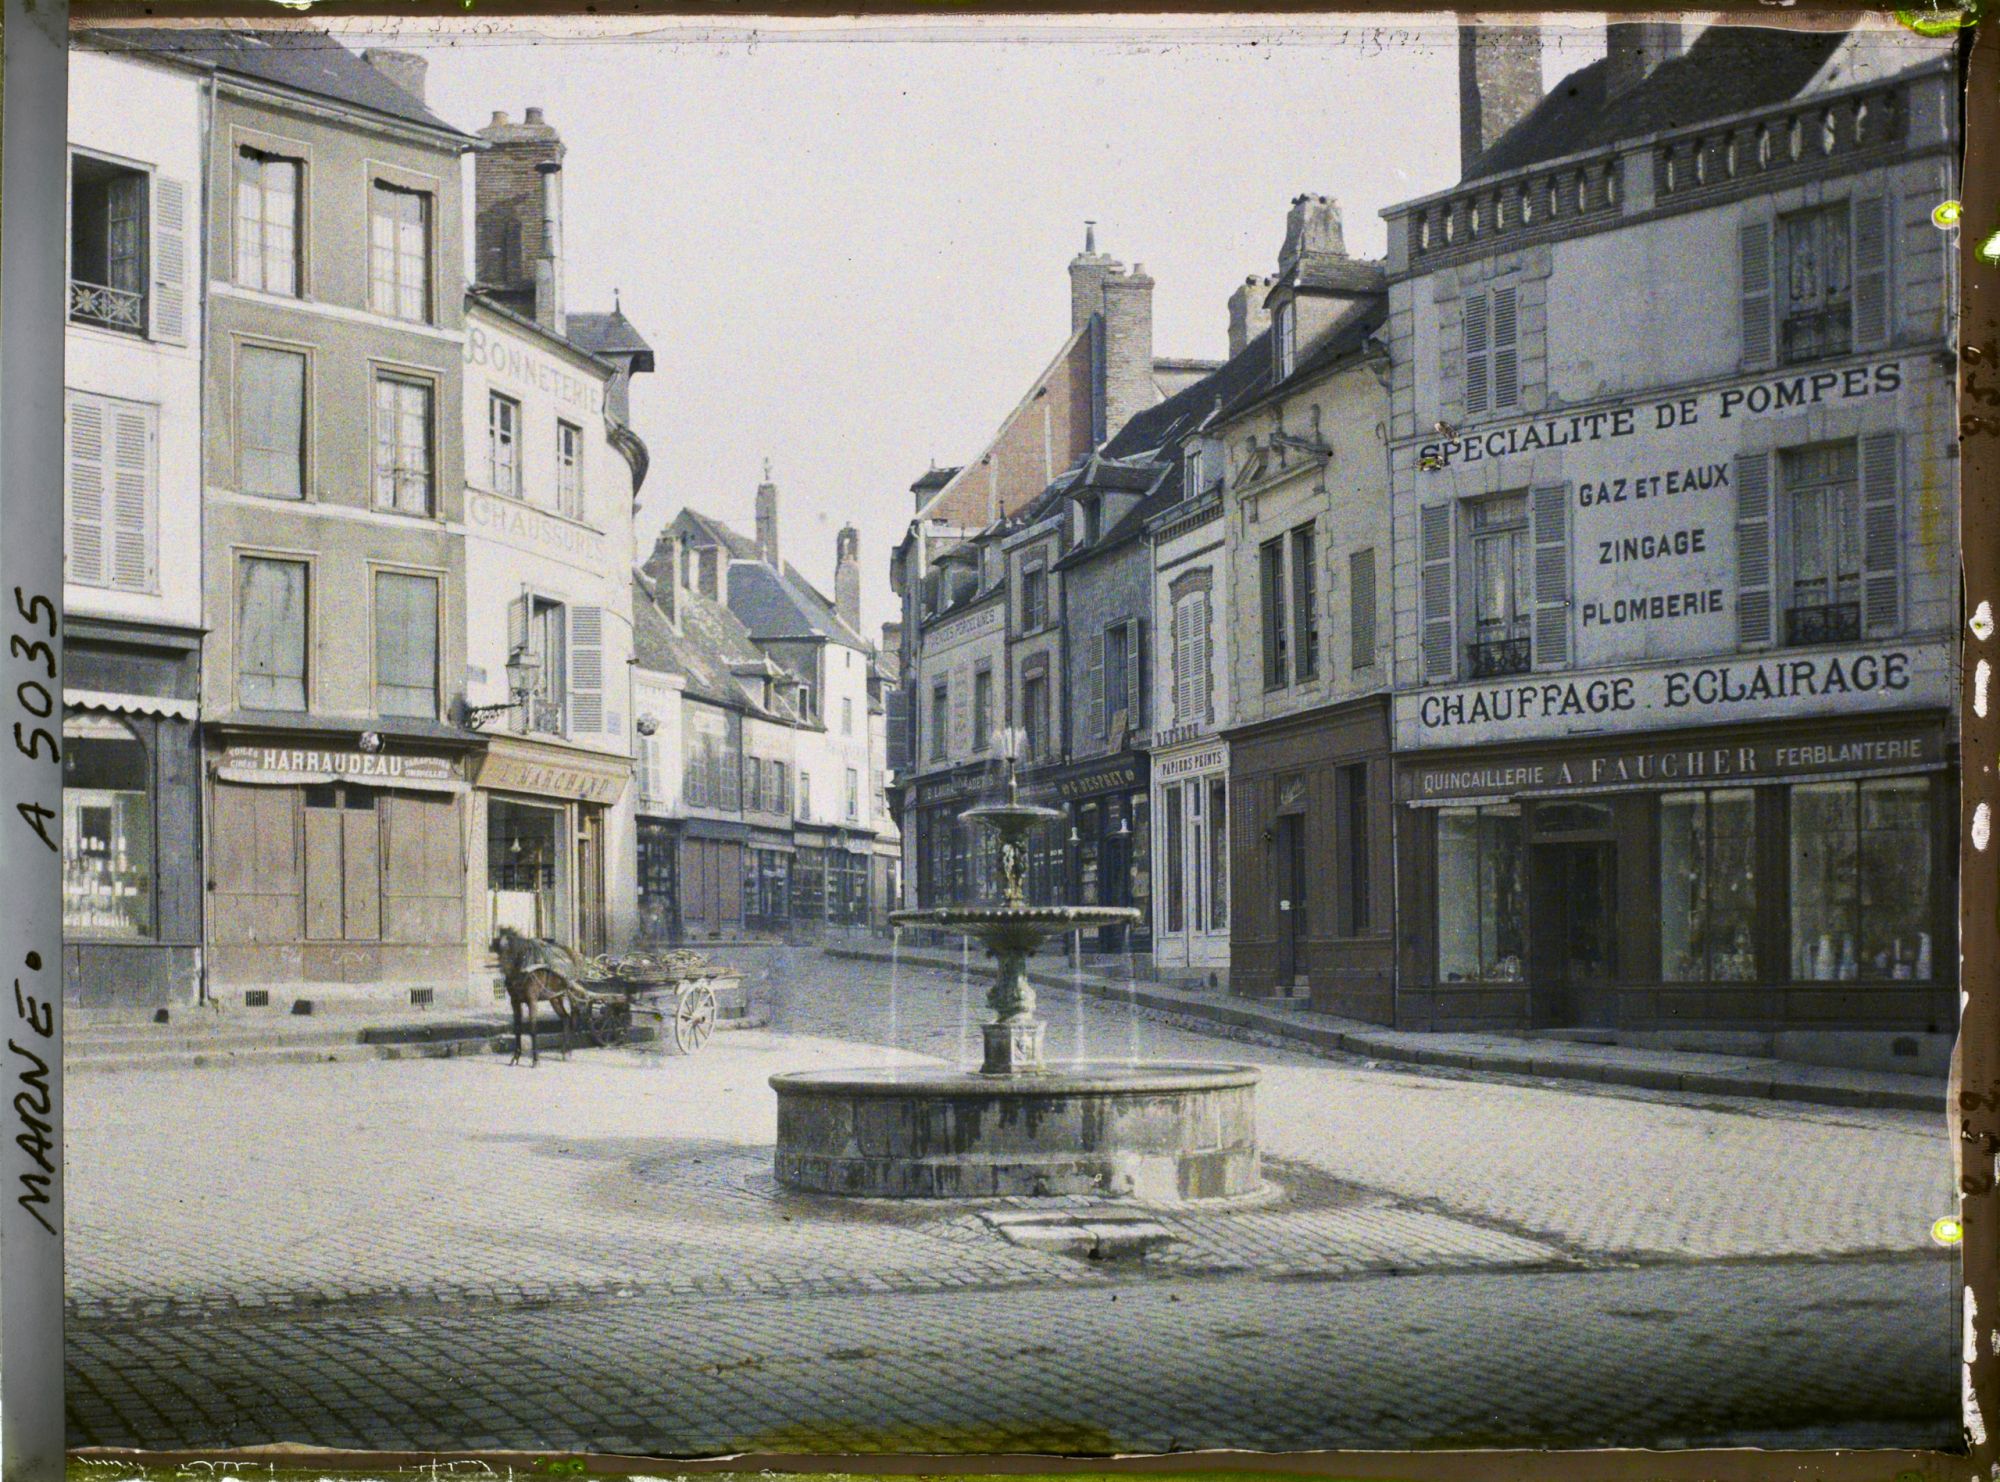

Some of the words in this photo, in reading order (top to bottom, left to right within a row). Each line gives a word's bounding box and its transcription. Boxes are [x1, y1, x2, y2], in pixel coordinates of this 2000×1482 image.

[464, 327, 601, 416] BONNETERIE
[1656, 398, 1699, 429] DE
[1720, 362, 1902, 419] POMPES
[1579, 478, 1628, 508] GAZ
[1635, 476, 1661, 499] ET
[1666, 462, 1730, 495] EAUX
[469, 495, 607, 562] CHAUSSURES
[1599, 528, 1706, 565] ZINGAGE
[1582, 588, 1724, 627] PLOMBERIE
[11, 587, 60, 764] 5035
[1419, 677, 1636, 729] CHAUFFAGE
[1663, 651, 1911, 708] ECLAIRAGE
[263, 749, 402, 777] HARRAUDEAU
[517, 765, 610, 796] MARCHAND
[1162, 756, 1192, 776] PAPIERS
[1194, 751, 1222, 769] PEINTS
[1424, 765, 1545, 795] QUINCAILLERIE
[1591, 746, 1759, 783] FAUCHER
[1775, 738, 1923, 767] FERBLANTERIE
[16, 801, 58, 853] A
